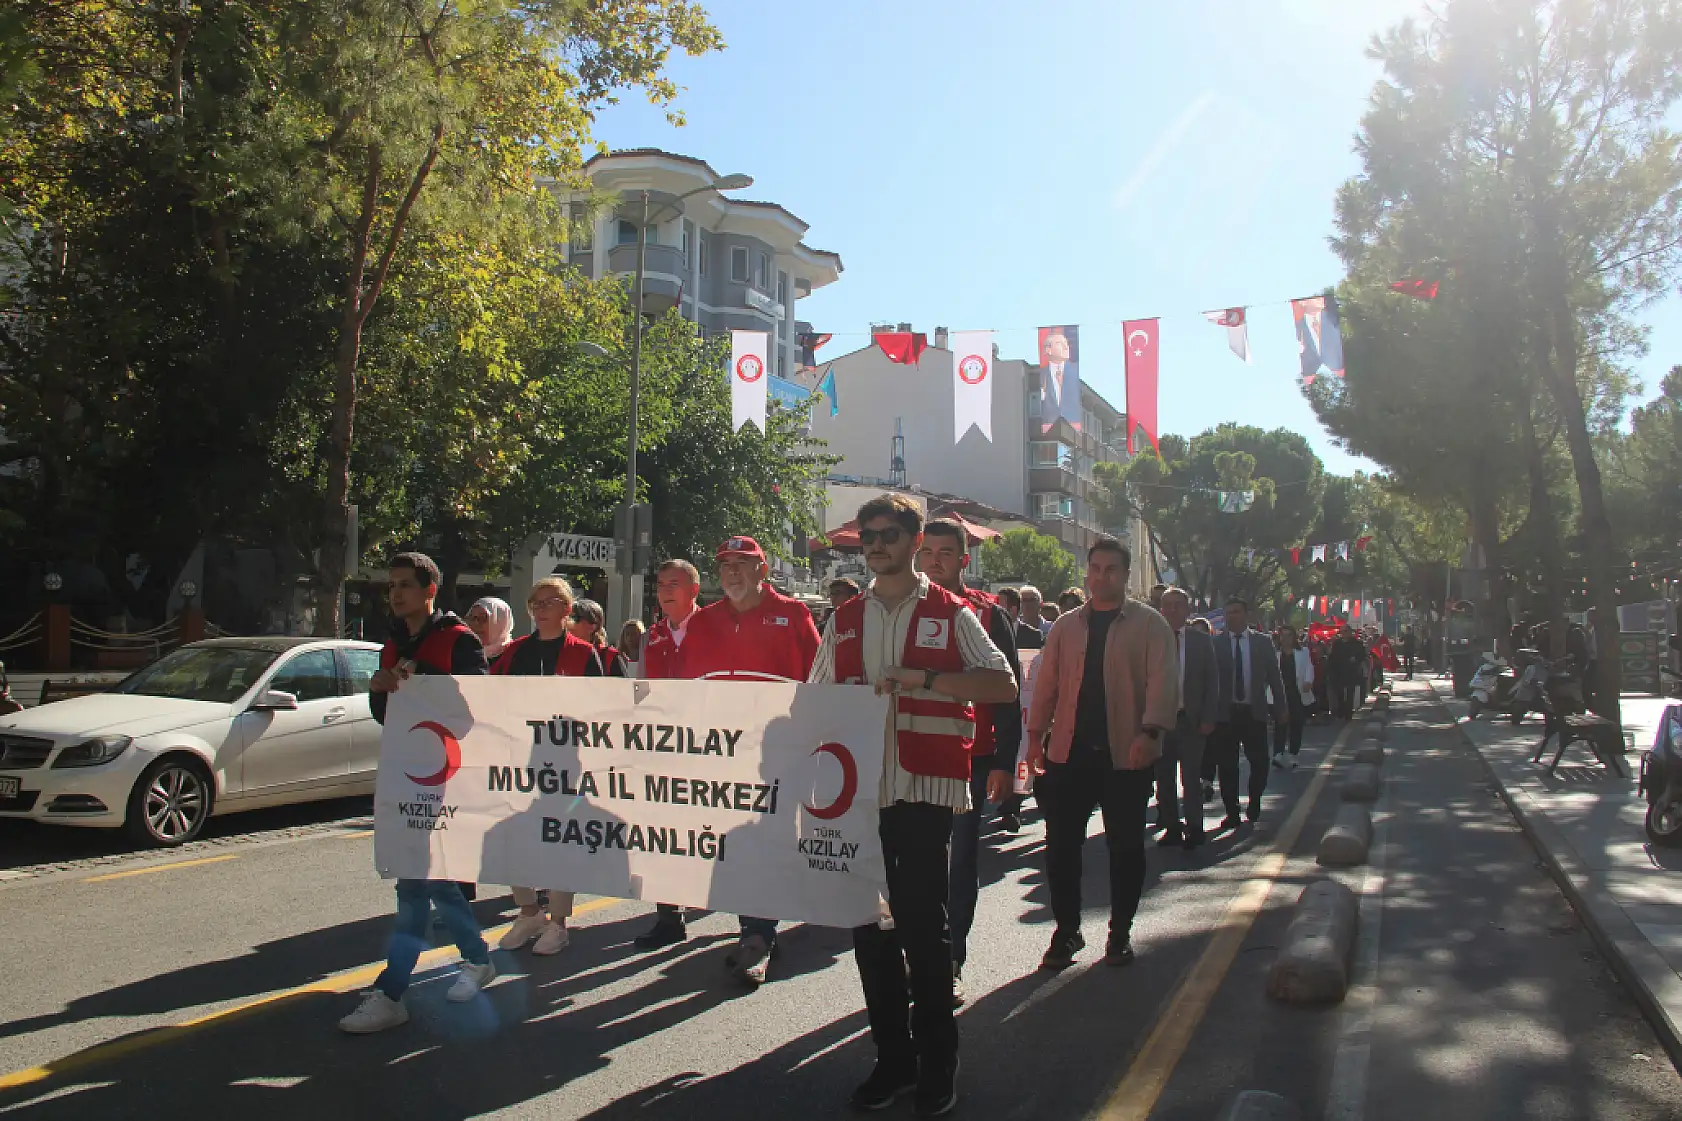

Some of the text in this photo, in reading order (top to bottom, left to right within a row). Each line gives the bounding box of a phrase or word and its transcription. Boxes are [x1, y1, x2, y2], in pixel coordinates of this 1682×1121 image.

[526, 714, 744, 758] TÜRK KIZILAY
[416, 792, 443, 802] TÜRK
[488, 762, 780, 815] MUĞLA İL MERKEZİ
[398, 802, 458, 819] KIZILAY
[407, 819, 448, 831] MUĞLA
[813, 827, 842, 839] TÜRK
[541, 816, 727, 862] BAŞKANLIĞI
[798, 838, 860, 860] KIZILAY
[808, 859, 850, 873] MUĞLA
